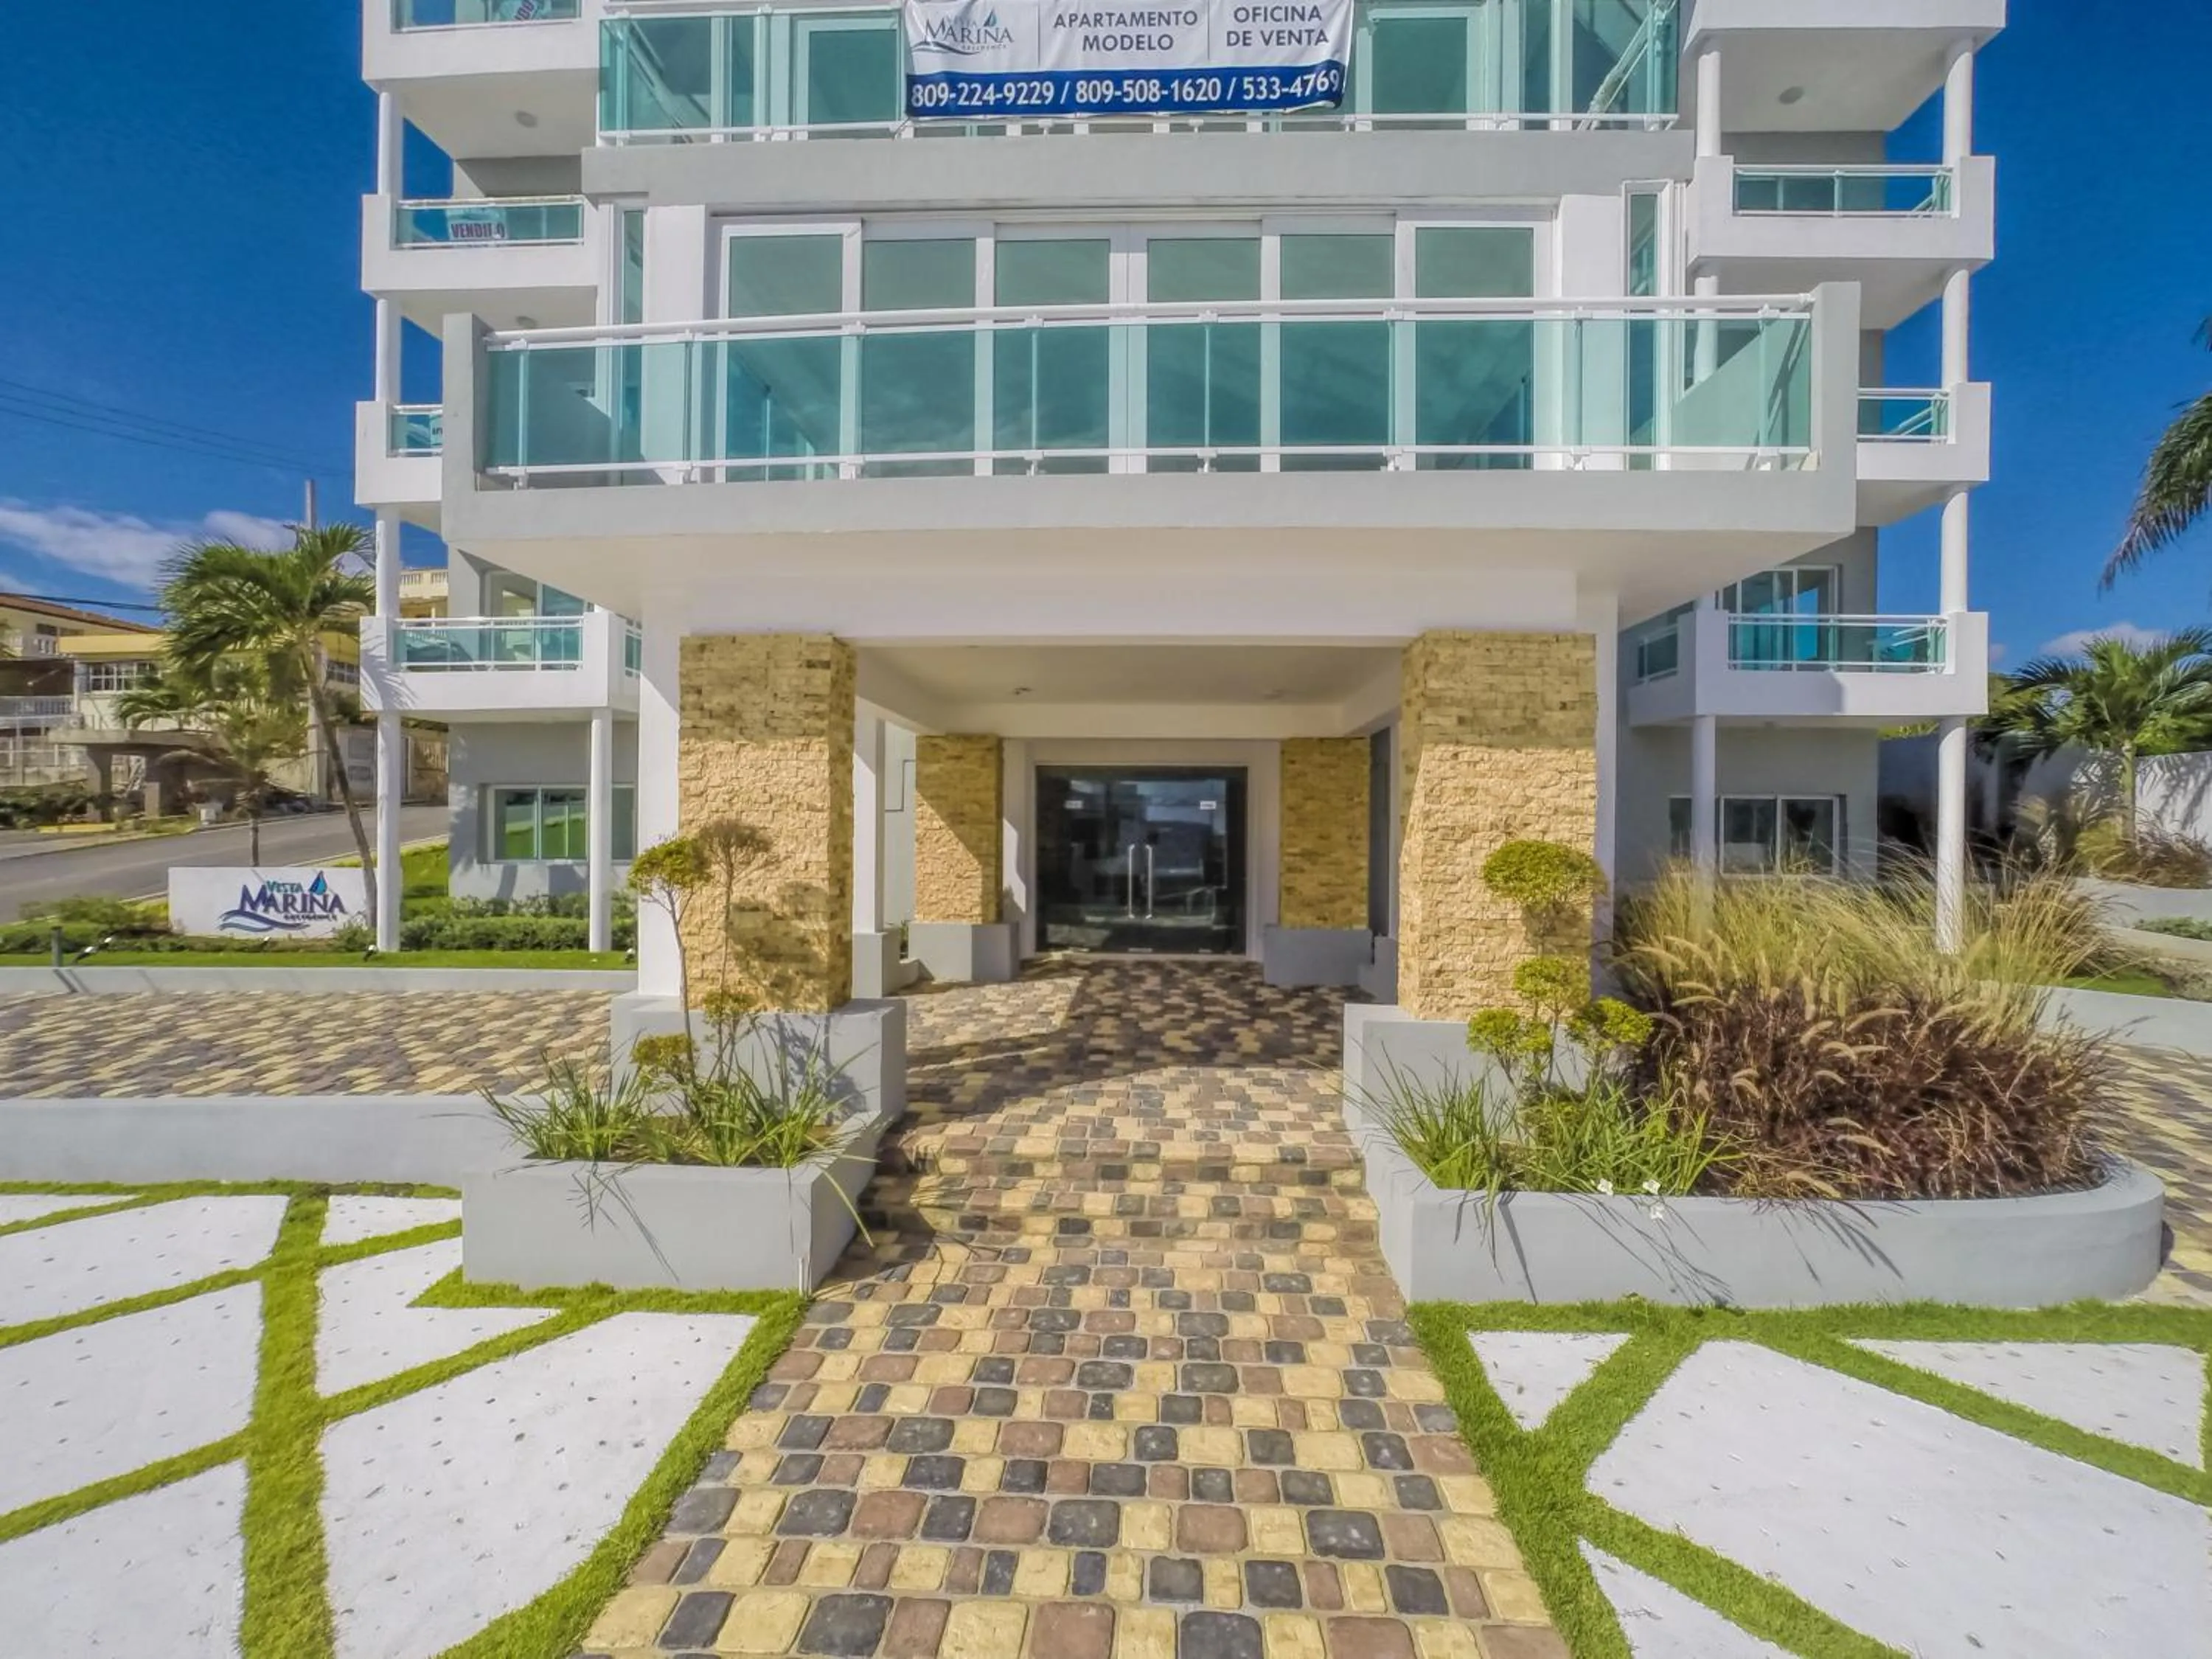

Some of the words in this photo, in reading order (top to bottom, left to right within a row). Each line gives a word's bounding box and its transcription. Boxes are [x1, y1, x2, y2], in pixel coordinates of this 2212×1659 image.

[1054, 10, 1198, 29] APARTAMENTO
[1234, 4, 1322, 23] OFICINA
[924, 17, 1015, 44] MARINA
[1226, 30, 1253, 46] DE
[1260, 29, 1329, 46] VENTA
[1082, 34, 1175, 52] MODELO
[911, 80, 1054, 107] 809-224-9229
[1075, 77, 1222, 104] 809-508-1620
[1242, 69, 1340, 100] 533-4769
[240, 884, 348, 914] MARINA
